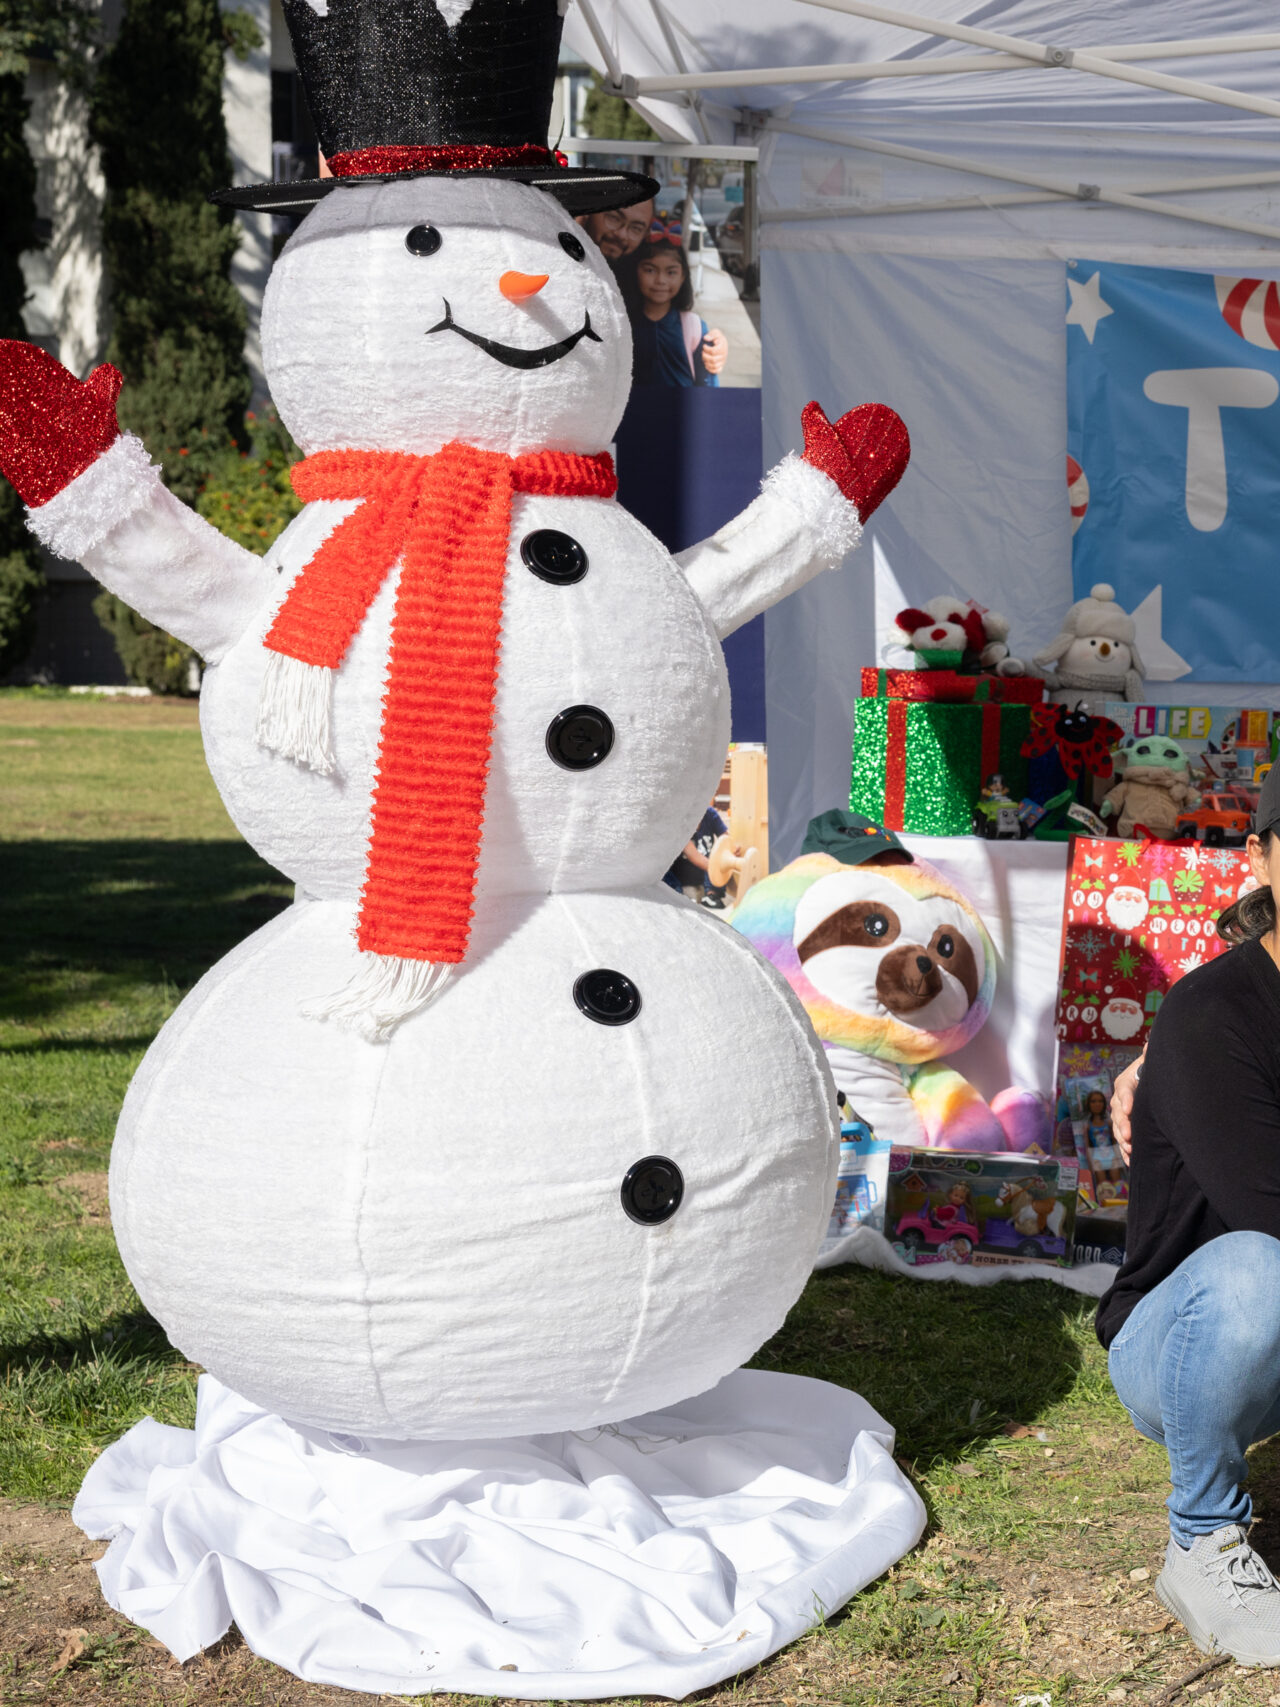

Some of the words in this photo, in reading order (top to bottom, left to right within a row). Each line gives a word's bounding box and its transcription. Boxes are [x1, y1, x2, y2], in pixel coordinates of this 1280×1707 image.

[1137, 708, 1207, 736] LIFE
[1150, 919, 1214, 936] MERR
[1110, 932, 1221, 953] CHRISTMA
